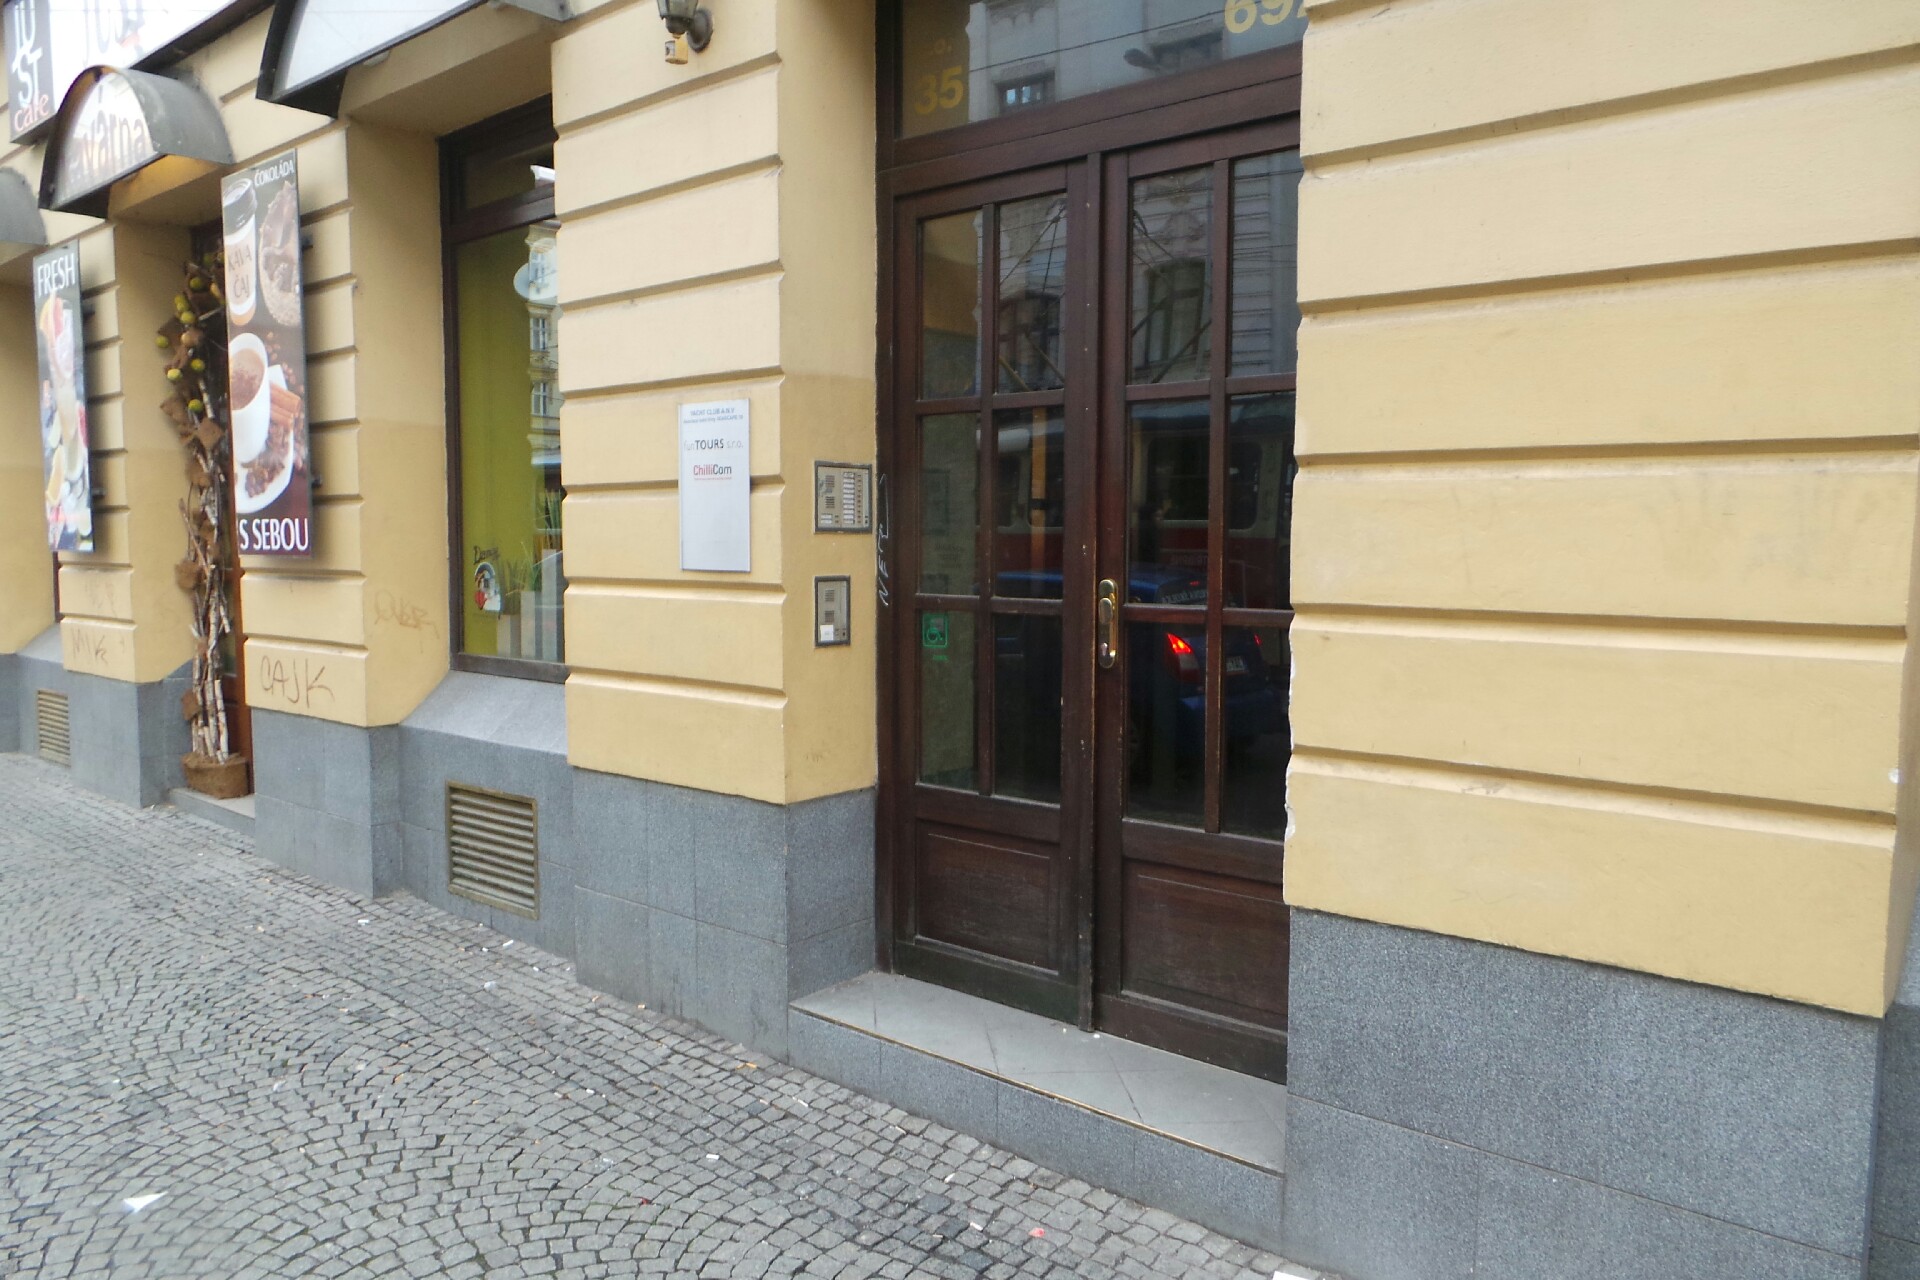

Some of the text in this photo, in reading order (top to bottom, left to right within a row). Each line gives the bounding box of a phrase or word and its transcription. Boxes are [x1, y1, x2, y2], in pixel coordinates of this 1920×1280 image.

[914, 65, 964, 116] 35
[37, 252, 76, 298] FRESH
[693, 463, 732, 476] ChilliCom
[239, 517, 309, 551] S SEBOU
